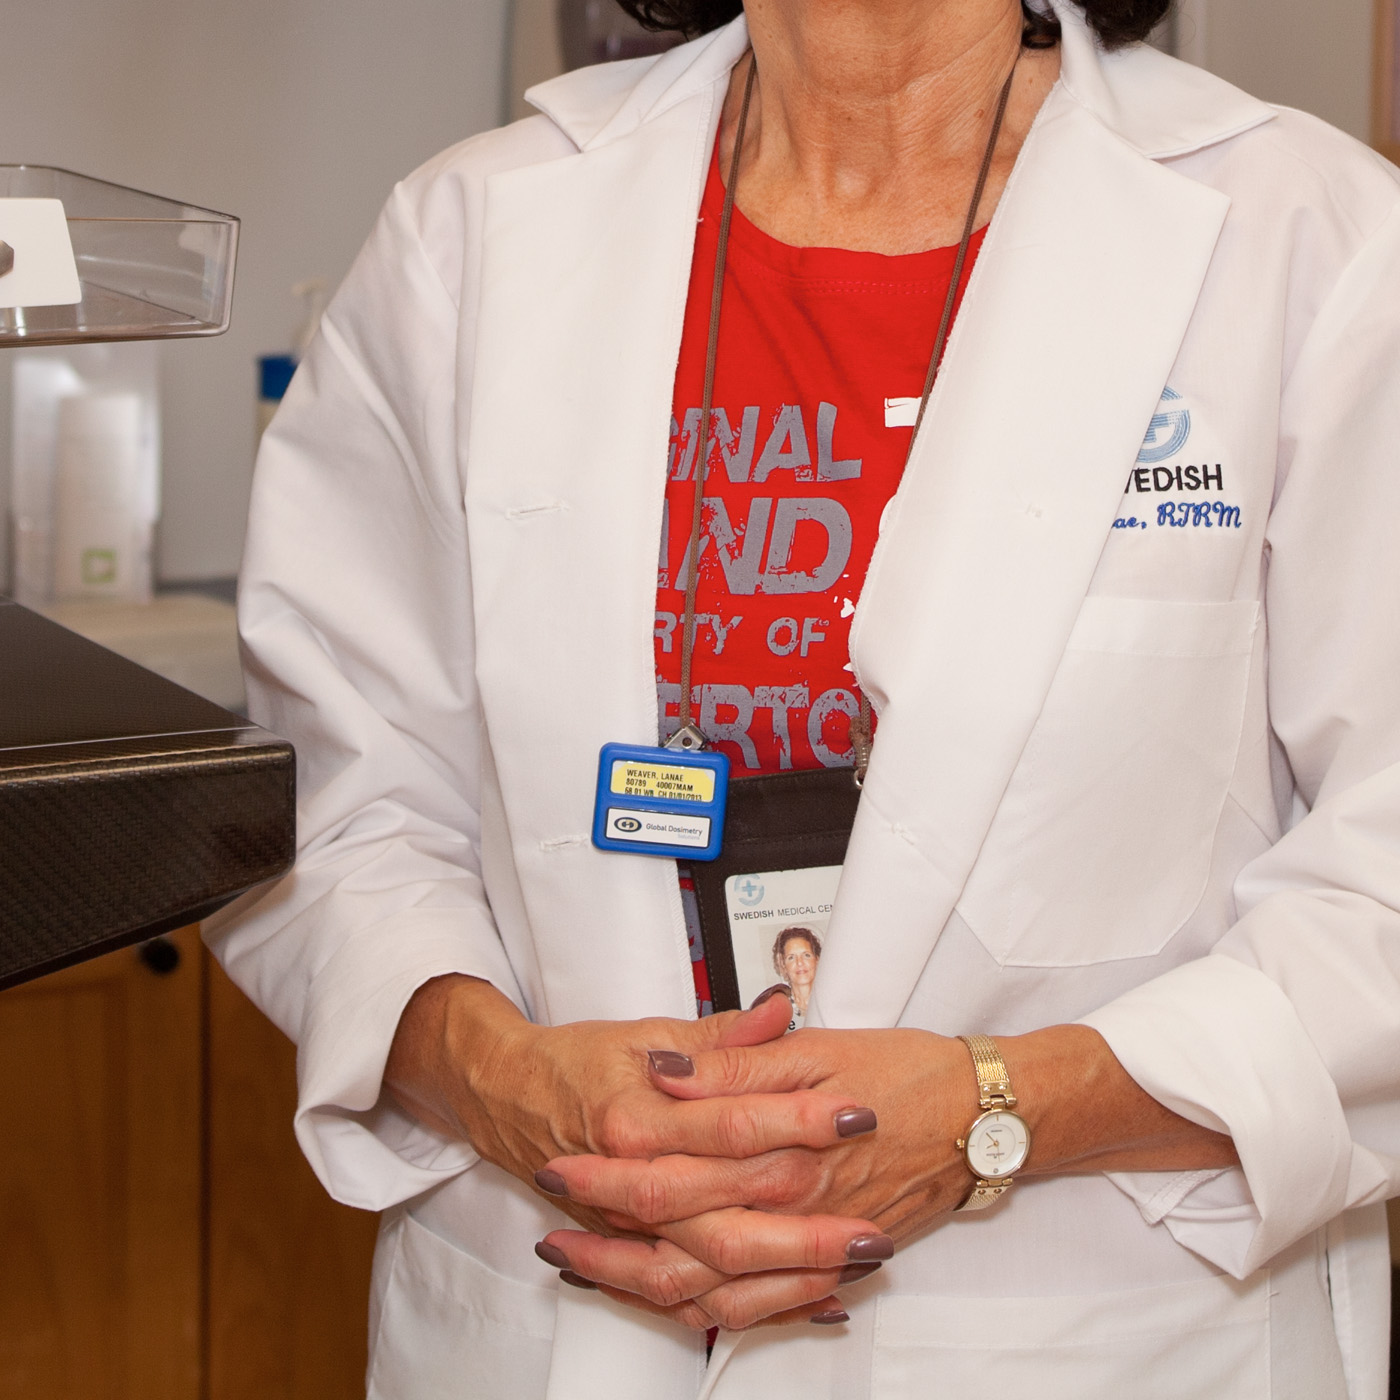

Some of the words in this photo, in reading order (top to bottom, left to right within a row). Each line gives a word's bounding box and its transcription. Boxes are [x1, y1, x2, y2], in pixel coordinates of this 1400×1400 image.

[766, 617, 830, 658] OF
[626, 769, 658, 779] WEAVER,
[661, 772, 684, 782] LANAE
[626, 778, 647, 787] 80789
[646, 822, 667, 832] Global
[668, 825, 703, 836] Dosimetry
[733, 910, 774, 920] SWEDISH
[777, 906, 816, 917] MEDICAL
